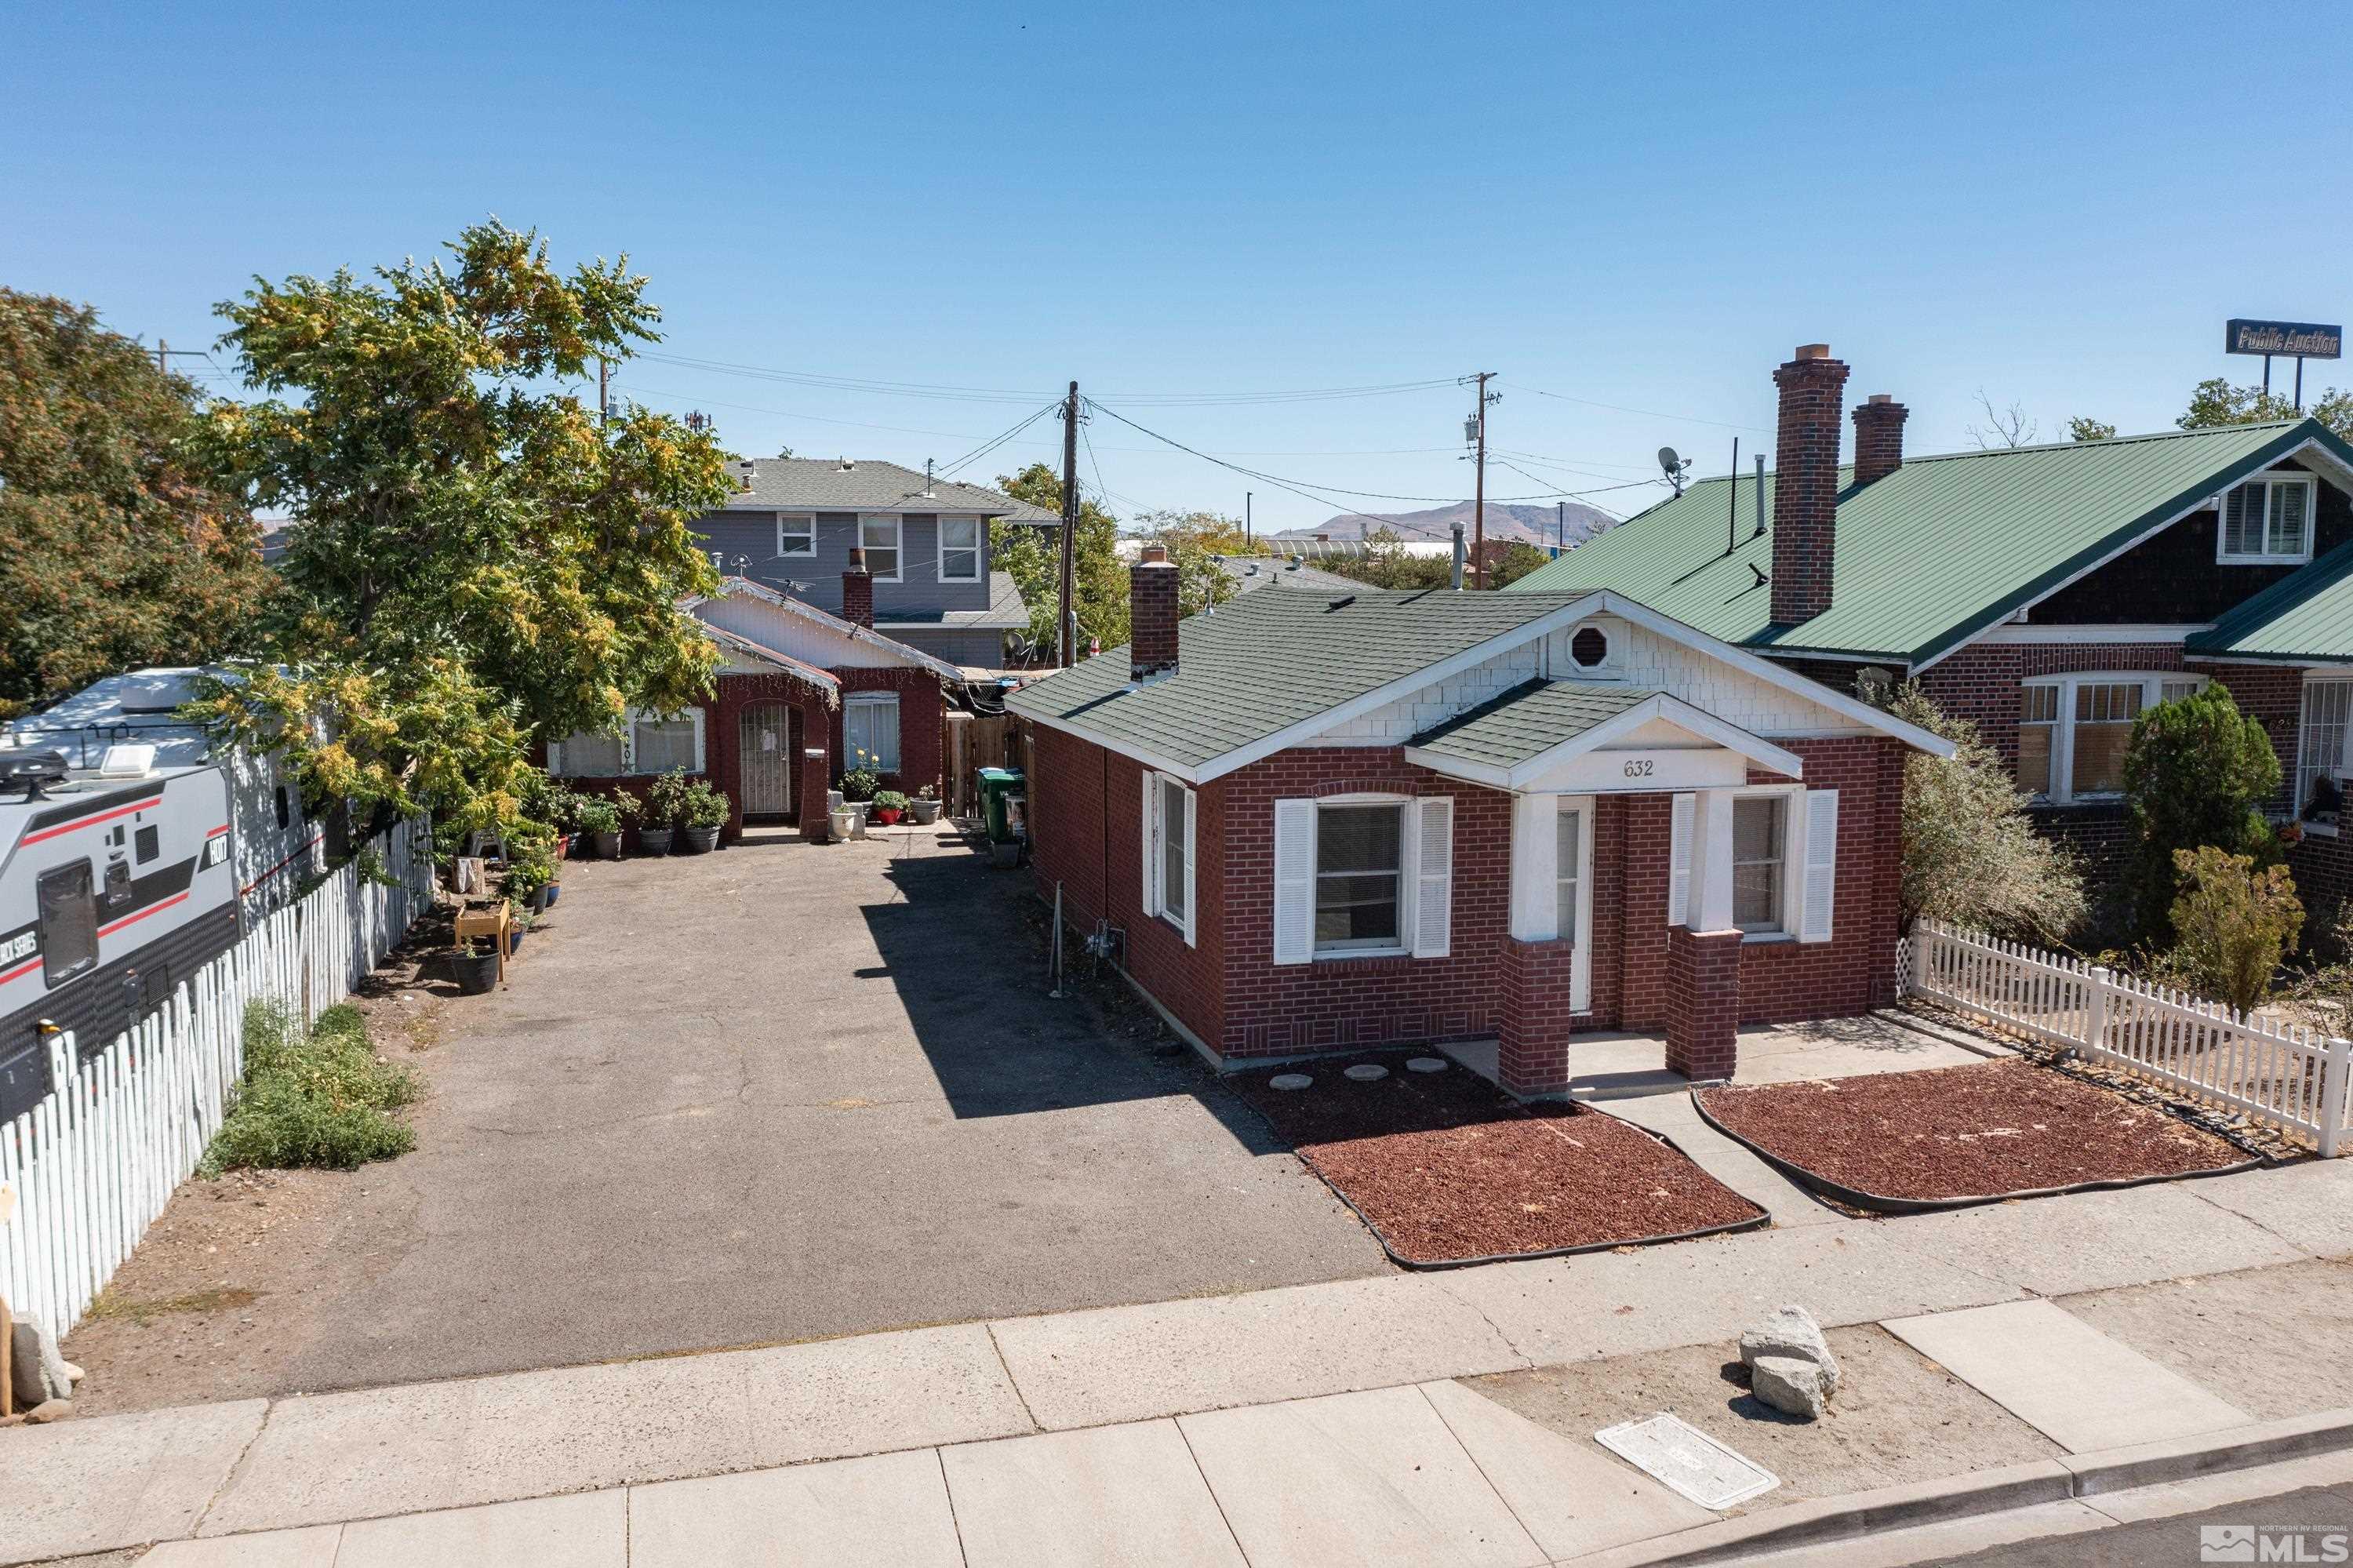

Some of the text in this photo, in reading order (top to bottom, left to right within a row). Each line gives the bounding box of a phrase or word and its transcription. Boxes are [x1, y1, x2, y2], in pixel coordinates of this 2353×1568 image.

[2238, 326, 2339, 353] Public Auction
[1624, 760, 1653, 777] 632
[13, 930, 38, 959] SERIES
